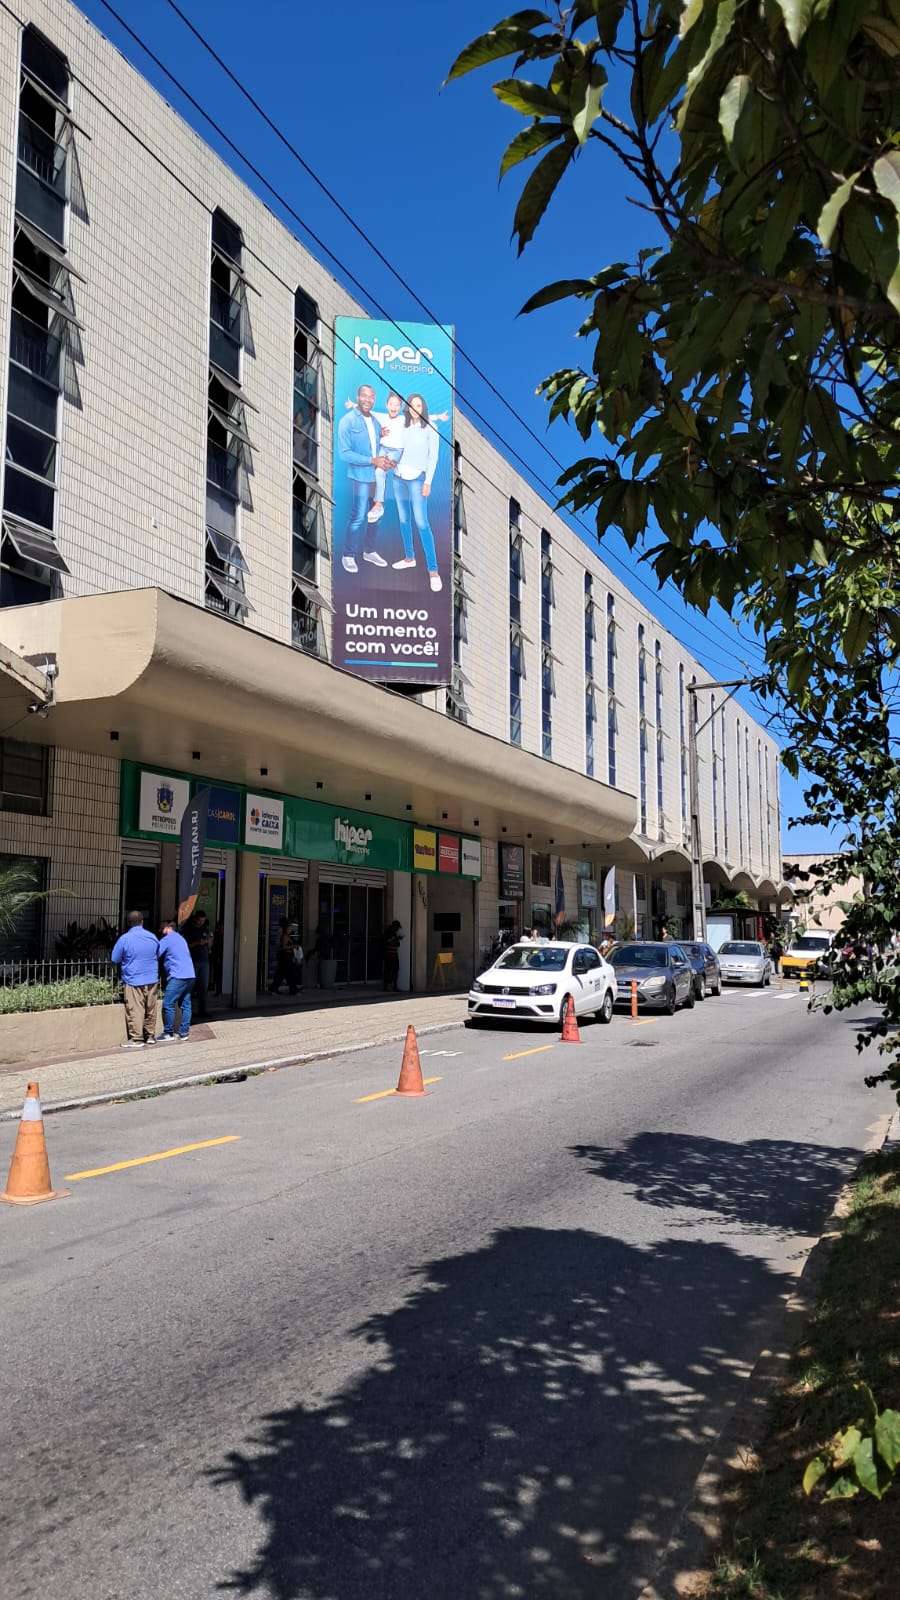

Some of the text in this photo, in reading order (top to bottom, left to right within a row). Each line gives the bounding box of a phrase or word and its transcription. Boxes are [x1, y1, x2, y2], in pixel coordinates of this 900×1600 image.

[354, 336, 433, 369] hiper
[389, 364, 434, 375] shopping
[345, 603, 429, 621] Um novo
[345, 623, 437, 638] momento
[345, 641, 439, 656] com você!
[261, 819, 280, 829] CAIXA
[335, 817, 372, 850] hiper
